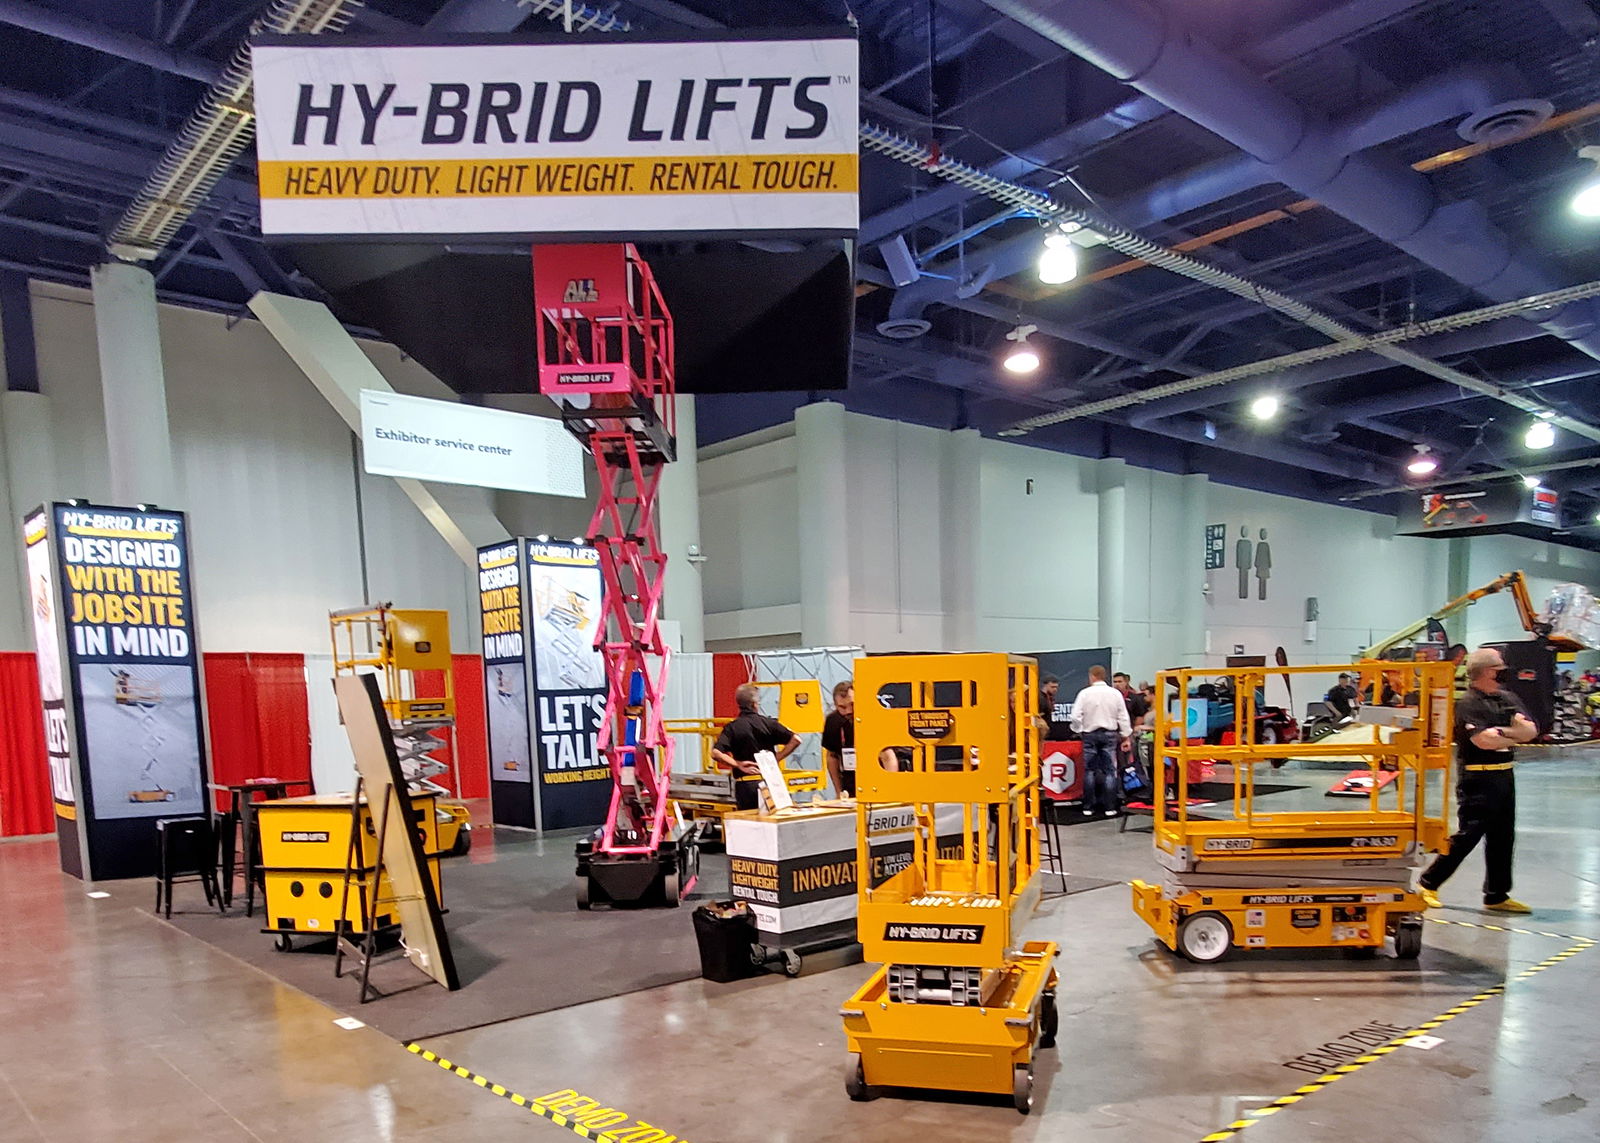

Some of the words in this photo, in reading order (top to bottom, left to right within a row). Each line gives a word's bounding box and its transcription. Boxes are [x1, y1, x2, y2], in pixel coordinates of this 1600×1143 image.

[291, 80, 601, 146] HY-BRID
[628, 75, 832, 142] LIFTS
[285, 167, 369, 195] HEAVY
[373, 166, 440, 194] DUTY.
[455, 165, 529, 193] LIGHT
[535, 163, 634, 192] WEIGHT.
[649, 161, 741, 191] RENTAL
[752, 160, 838, 190] TOUGH.
[375, 427, 431, 445] Exhibitor
[435, 438, 475, 452] service
[478, 444, 513, 456] center
[136, 515, 181, 535] LIFTS
[64, 536, 181, 568] DESIGNED
[65, 564, 137, 593] WITH
[139, 568, 183, 596] THE
[70, 592, 186, 628] JOBSITE
[74, 625, 109, 657] IN
[114, 626, 190, 658] MIND
[484, 635, 496, 660] IN
[496, 633, 523, 658] MIND
[539, 693, 607, 732] LET'S
[544, 771, 583, 784] WORKING
[1050, 763, 1068, 783] R
[732, 859, 756, 874] HEAVY
[889, 926, 940, 939] HY-BRID
[942, 928, 978, 941] LIFTS
[1282, 1042, 1366, 1075] DEMO
[1337, 1019, 1413, 1047] ZONE
[534, 1088, 629, 1129] DEMO
